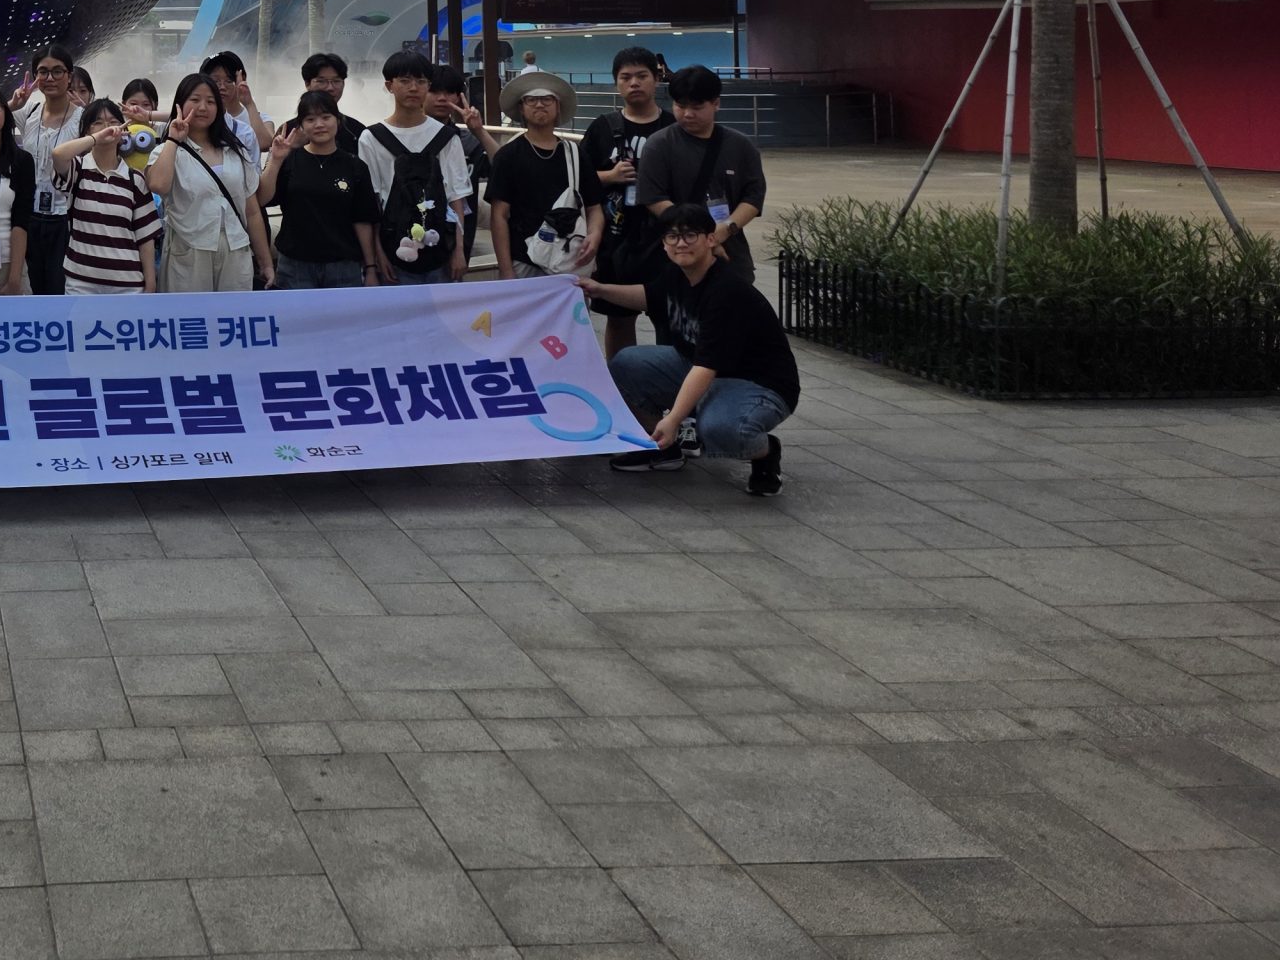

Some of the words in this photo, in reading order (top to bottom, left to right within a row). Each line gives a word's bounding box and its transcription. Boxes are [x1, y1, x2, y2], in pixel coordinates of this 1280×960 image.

[84, 317, 209, 351] 스위치를
[217, 315, 280, 349] 켜다
[540, 335, 568, 360] B
[28, 374, 247, 440] 글로벌
[259, 356, 548, 433] 문화체험
[50, 456, 90, 472] 장소
[111, 452, 188, 470] 싱가포르
[193, 450, 233, 466] 일대
[306, 444, 363, 458] 화순군
